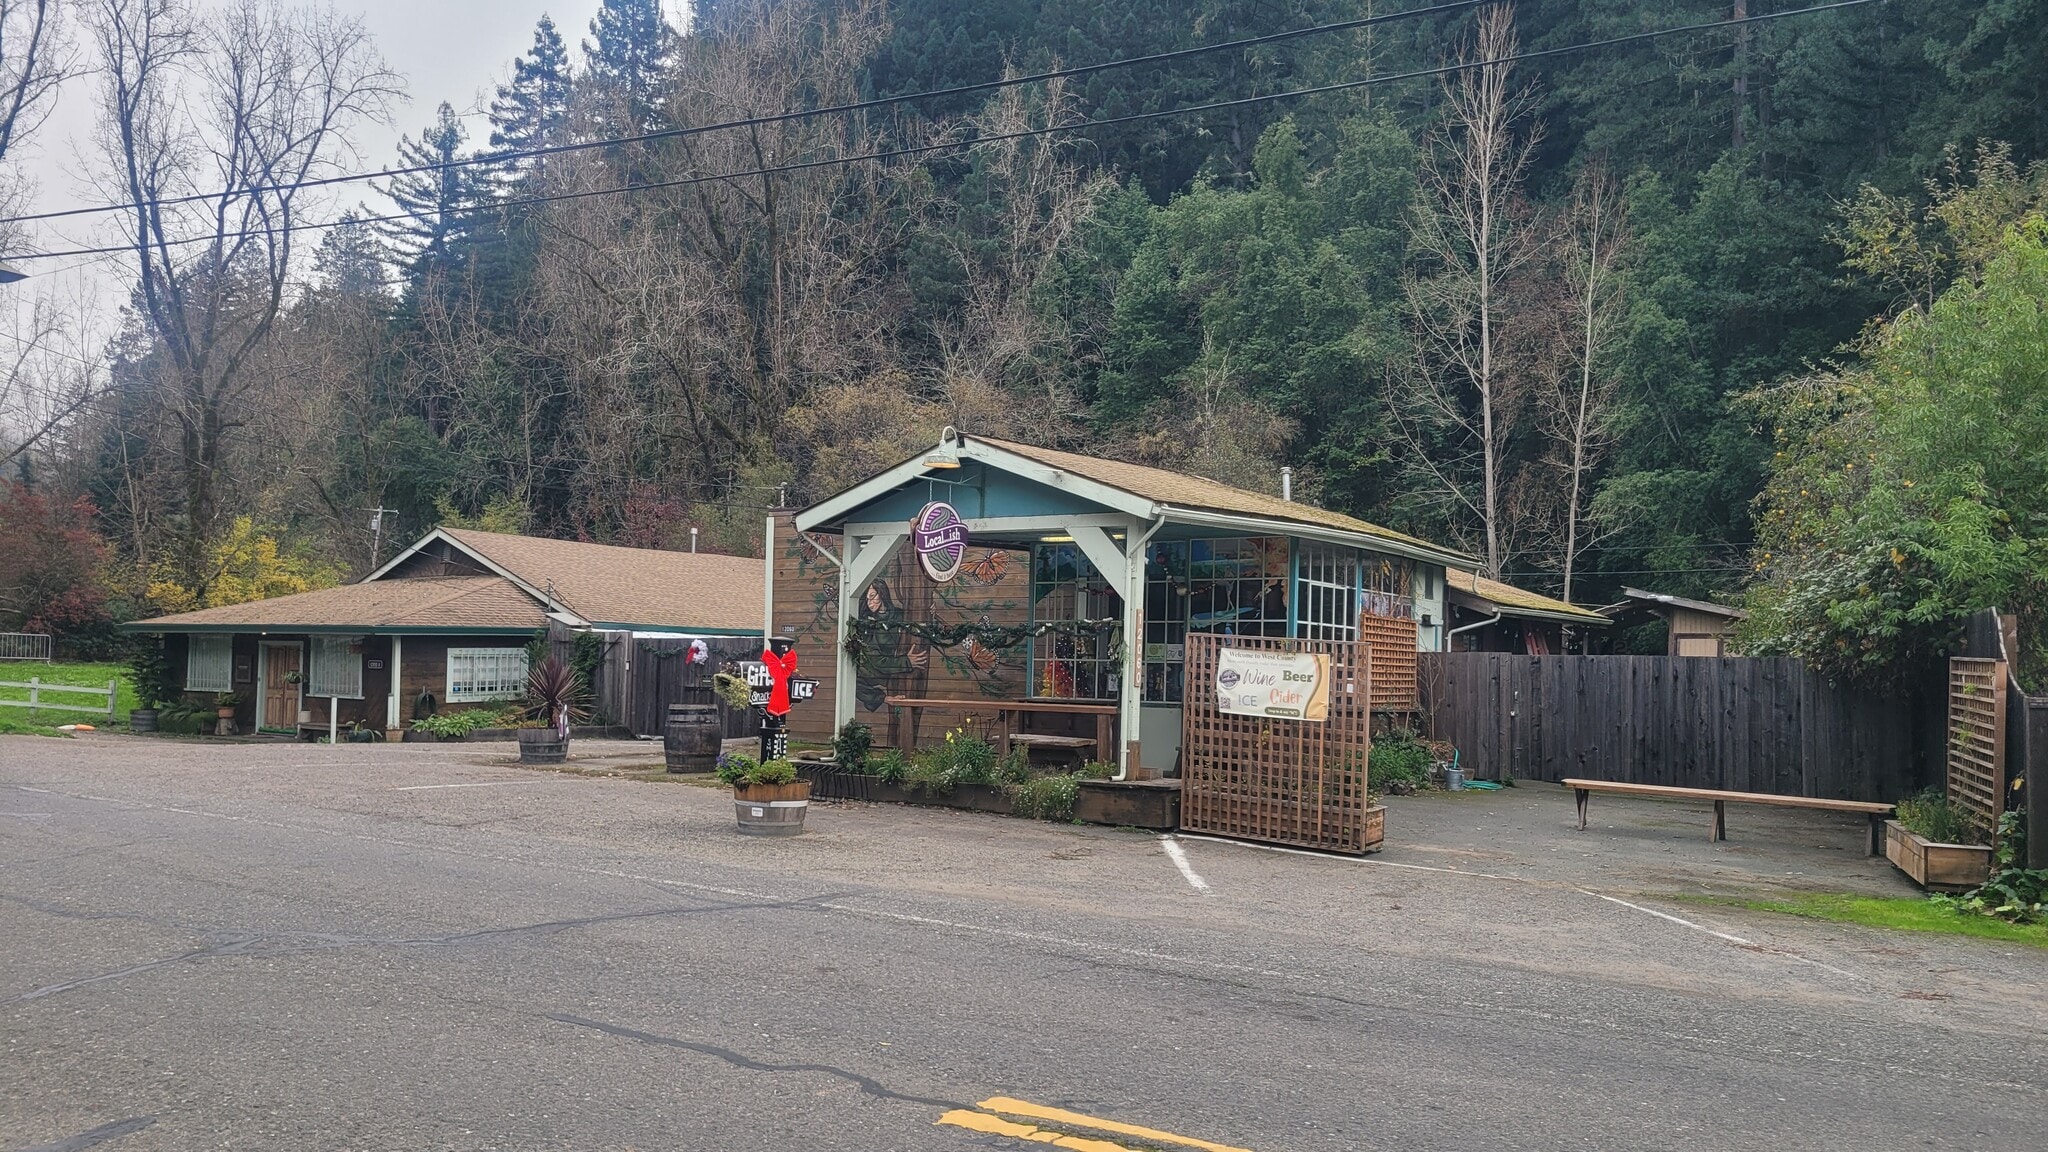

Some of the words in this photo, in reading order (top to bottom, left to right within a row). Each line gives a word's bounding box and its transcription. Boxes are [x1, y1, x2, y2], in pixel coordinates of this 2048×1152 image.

[1229, 651, 1253, 659] Welcome
[1242, 668, 1276, 686] Wine
[1282, 670, 1314, 683] Beer
[793, 682, 813, 697] ICE
[1269, 688, 1303, 705] Cider
[1238, 694, 1258, 707] ICE
